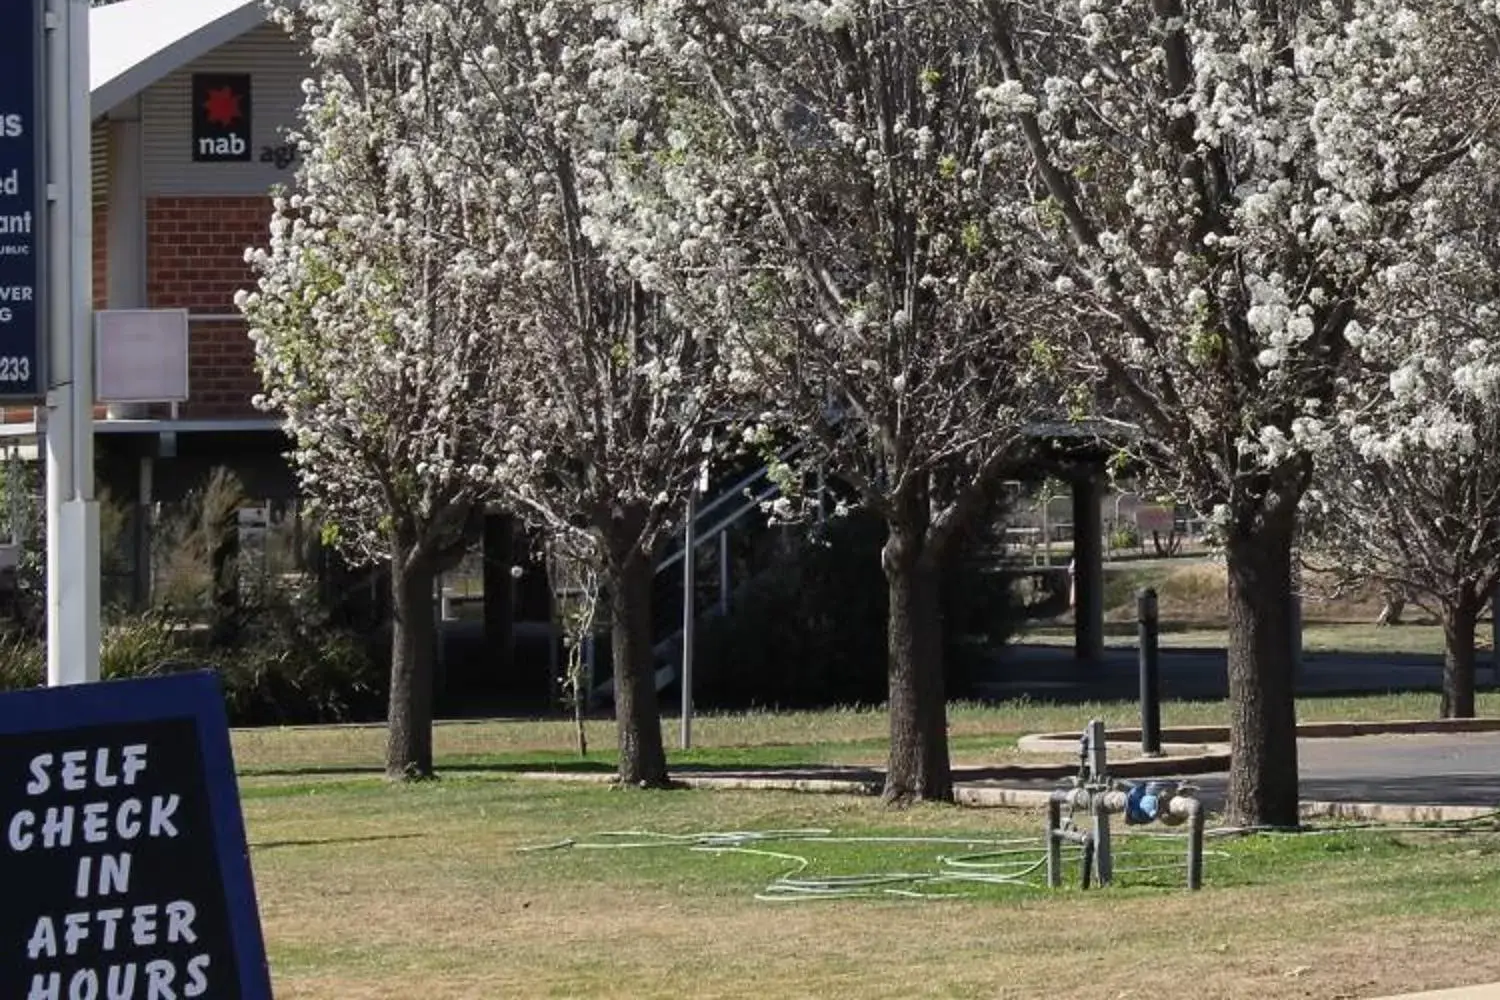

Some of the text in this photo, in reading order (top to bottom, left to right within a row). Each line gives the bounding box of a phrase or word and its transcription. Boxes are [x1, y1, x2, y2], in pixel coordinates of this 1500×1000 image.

[199, 132, 246, 155] nab
[26, 744, 148, 795] SELF
[8, 795, 180, 851] CHECK
[76, 853, 132, 897] IN
[27, 900, 198, 959] AFTER
[26, 954, 211, 1000] HOURS
